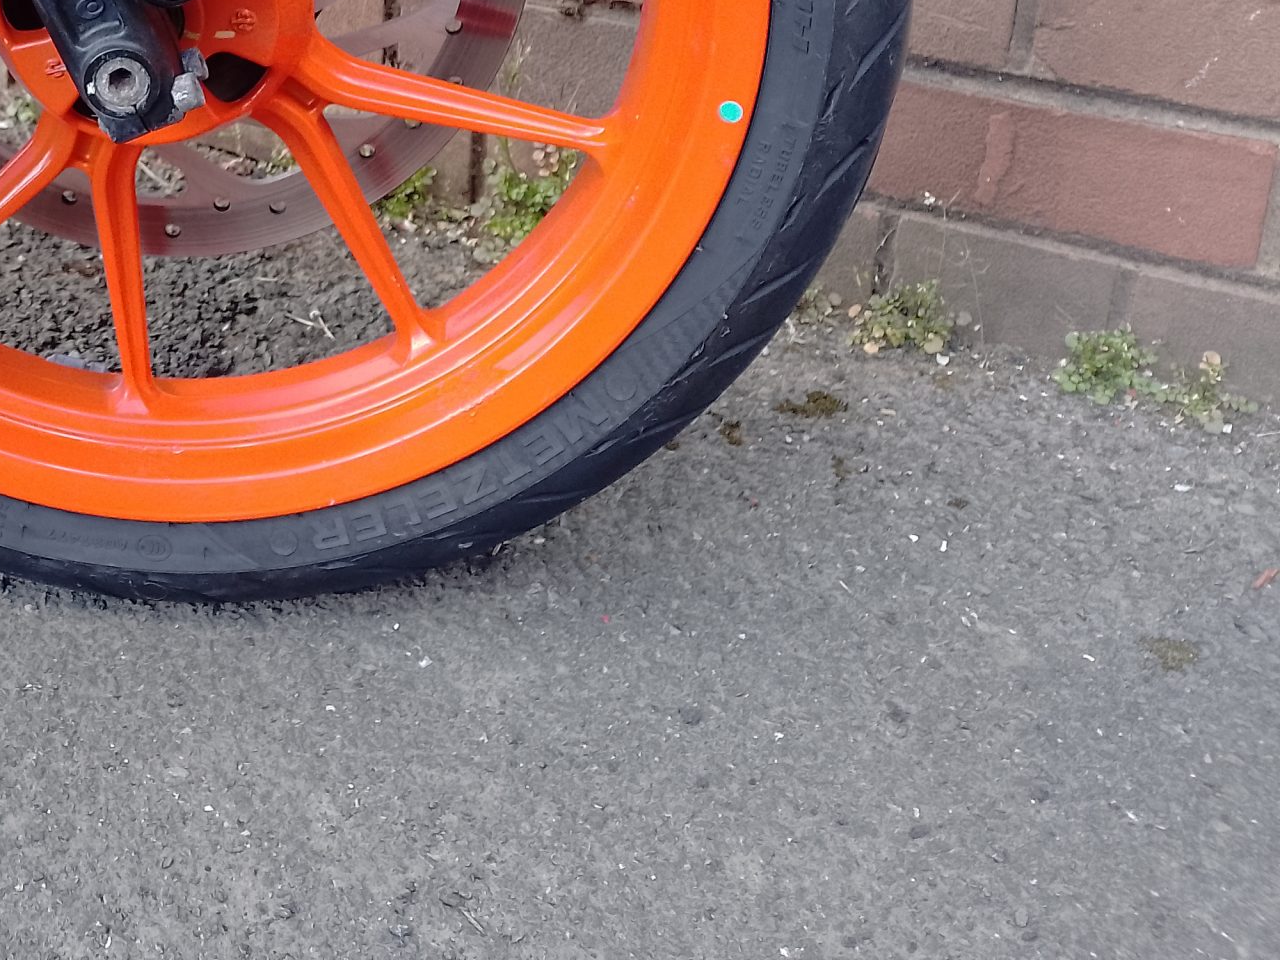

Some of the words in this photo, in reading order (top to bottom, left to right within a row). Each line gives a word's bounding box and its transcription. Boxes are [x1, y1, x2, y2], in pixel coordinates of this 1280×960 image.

[734, 138, 773, 212] RADIAL
[750, 135, 798, 232] TUBELESS
[314, 391, 609, 551] METZELER
